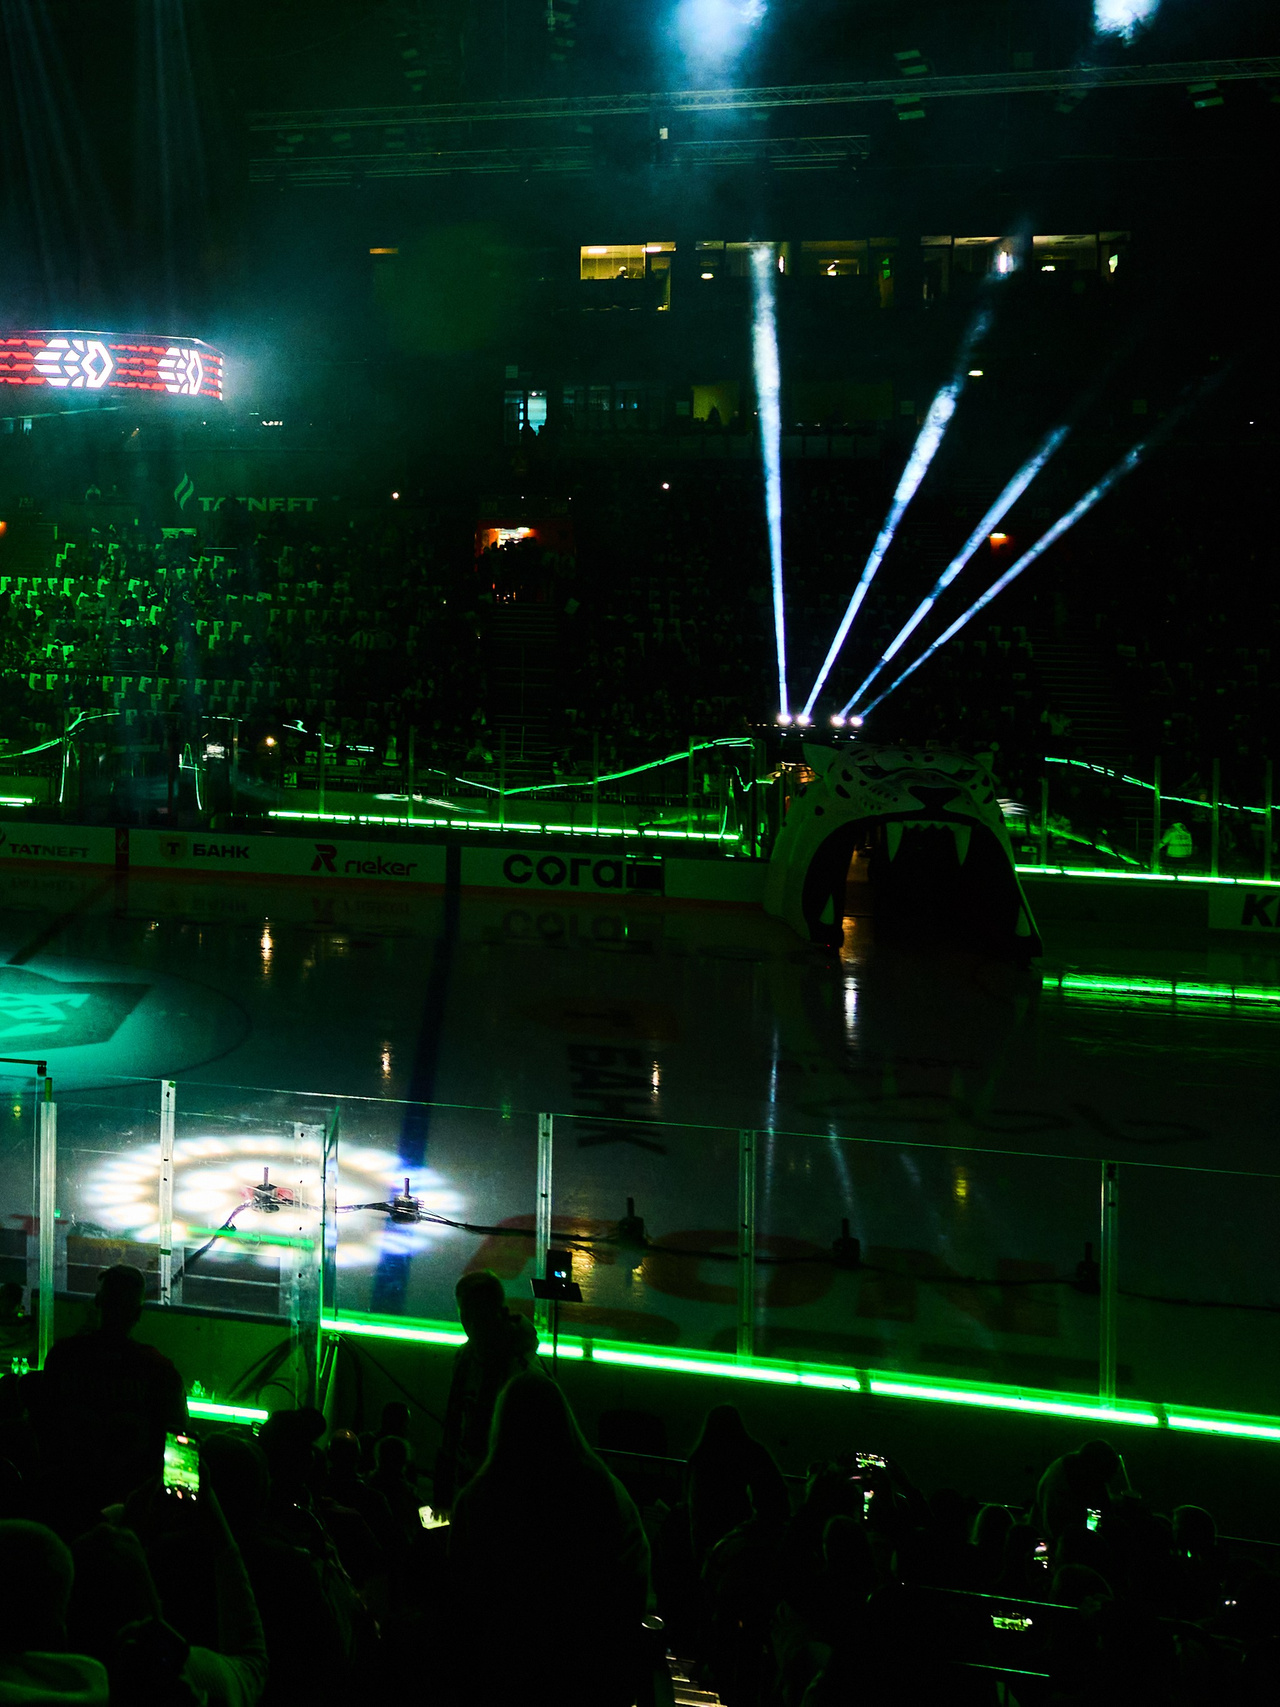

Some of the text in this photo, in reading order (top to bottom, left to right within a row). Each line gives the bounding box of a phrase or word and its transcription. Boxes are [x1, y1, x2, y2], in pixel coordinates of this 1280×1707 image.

[8, 842, 90, 858] TATNEFT
[192, 842, 250, 860] БАНК
[344, 855, 418, 876] rieker
